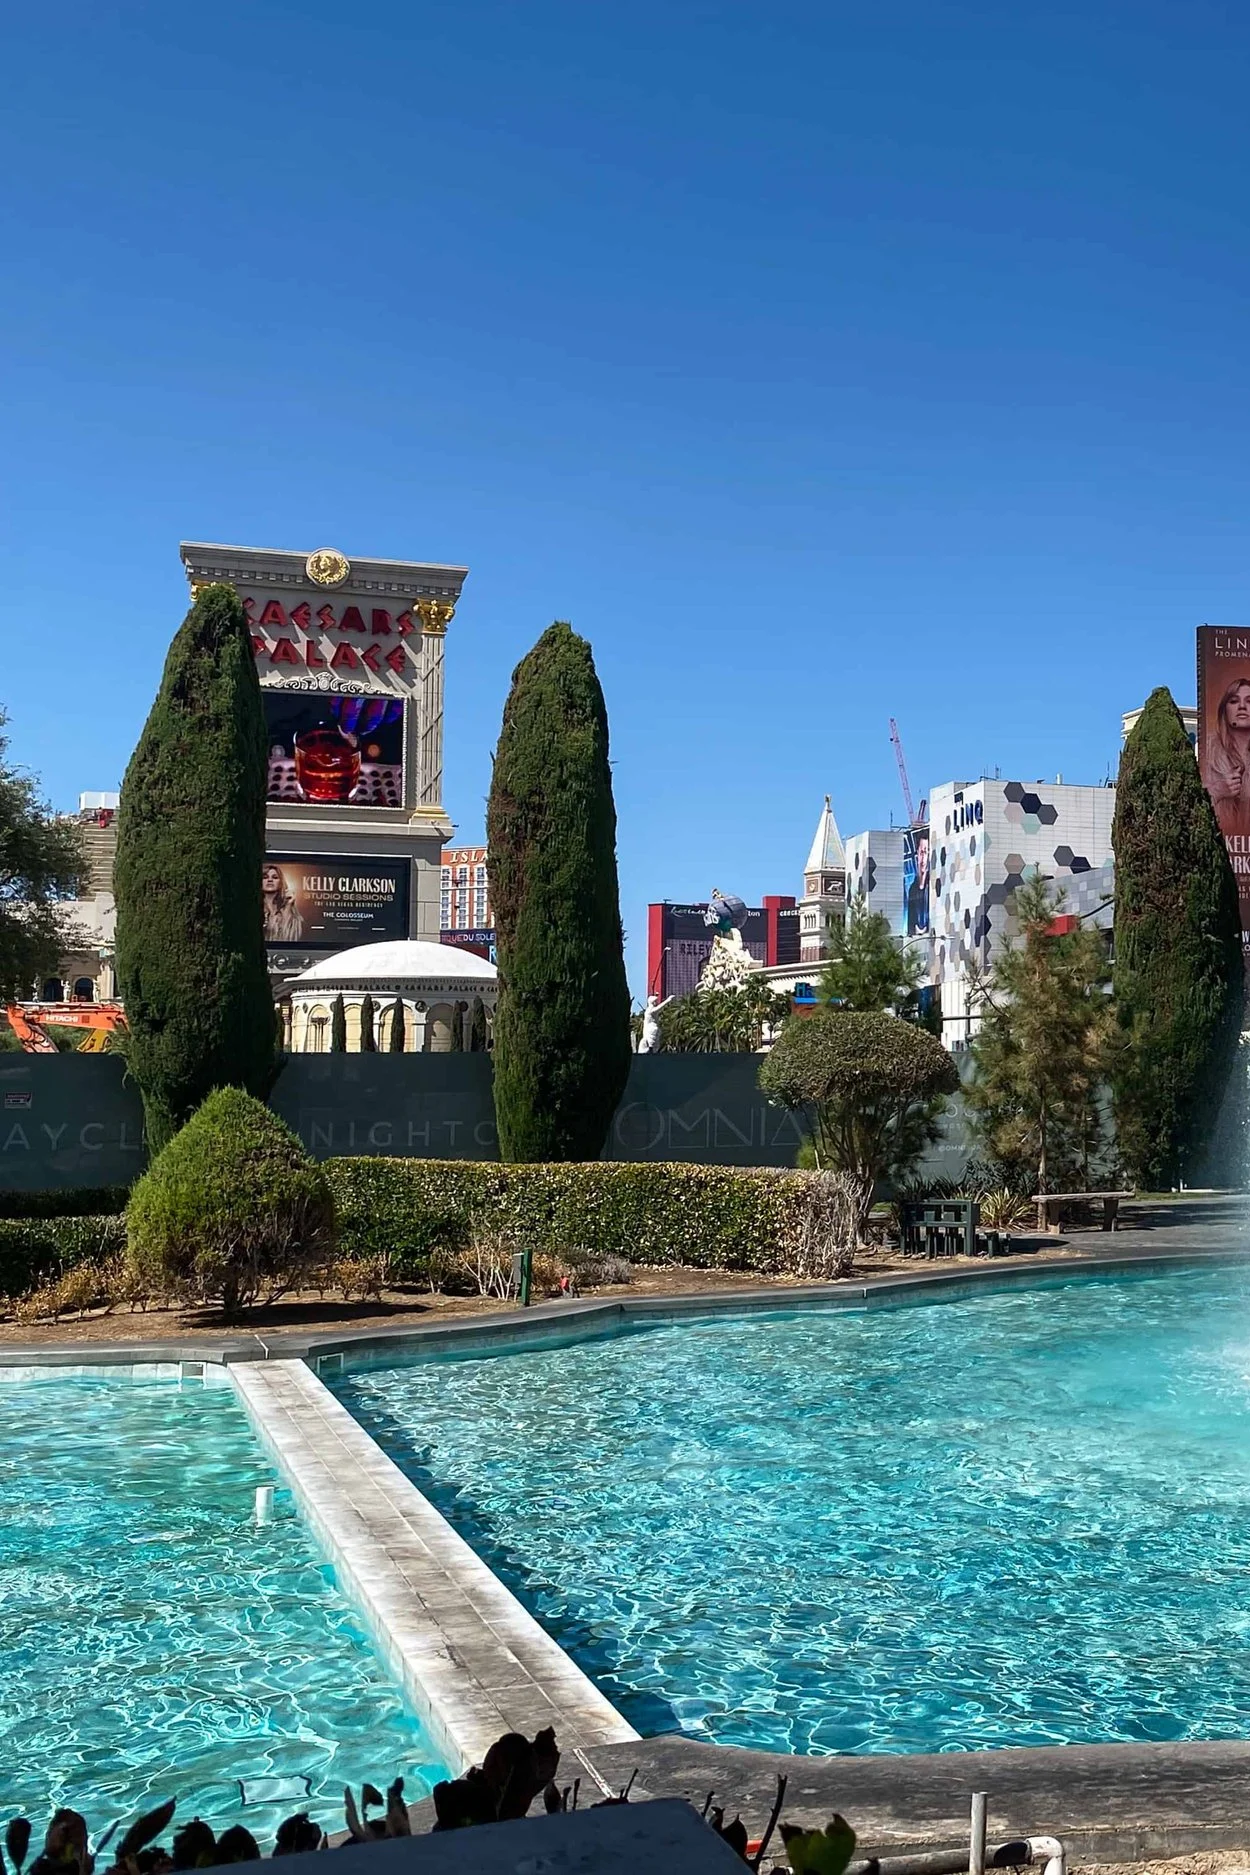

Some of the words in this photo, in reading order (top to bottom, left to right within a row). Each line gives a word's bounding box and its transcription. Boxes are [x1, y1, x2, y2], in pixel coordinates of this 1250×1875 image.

[303, 876, 335, 892] KELLY
[338, 877, 396, 894] CLARKSON
[304, 892, 341, 900] STUDIO
[343, 893, 394, 902] SESSIONS
[336, 911, 374, 919] COLOSSEUM
[476, 932, 497, 941] SOLE
[45, 1014, 79, 1023] HITACHI
